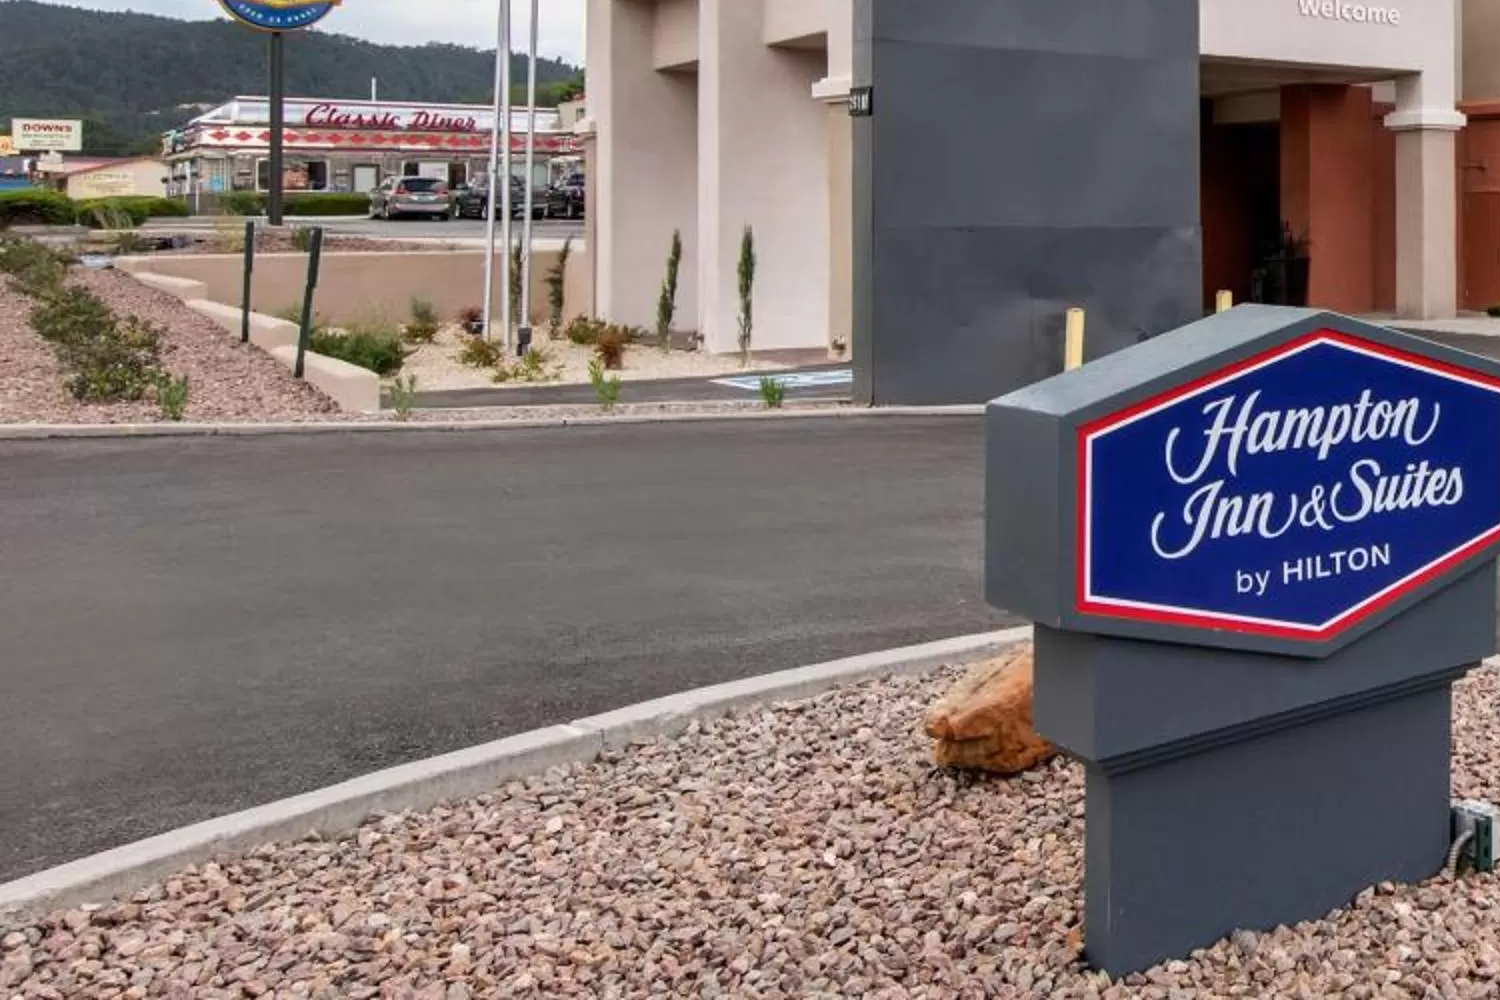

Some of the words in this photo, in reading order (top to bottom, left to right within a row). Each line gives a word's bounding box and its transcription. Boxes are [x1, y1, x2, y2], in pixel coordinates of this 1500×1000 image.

[305, 102, 400, 130] Classic
[406, 110, 478, 132] Diner
[1165, 389, 1441, 485] Hampton
[1151, 479, 1299, 559] Inn
[1299, 484, 1334, 531] &
[1330, 459, 1464, 523] Suites
[1236, 569, 1271, 596] by
[1283, 543, 1391, 585] HILTON
